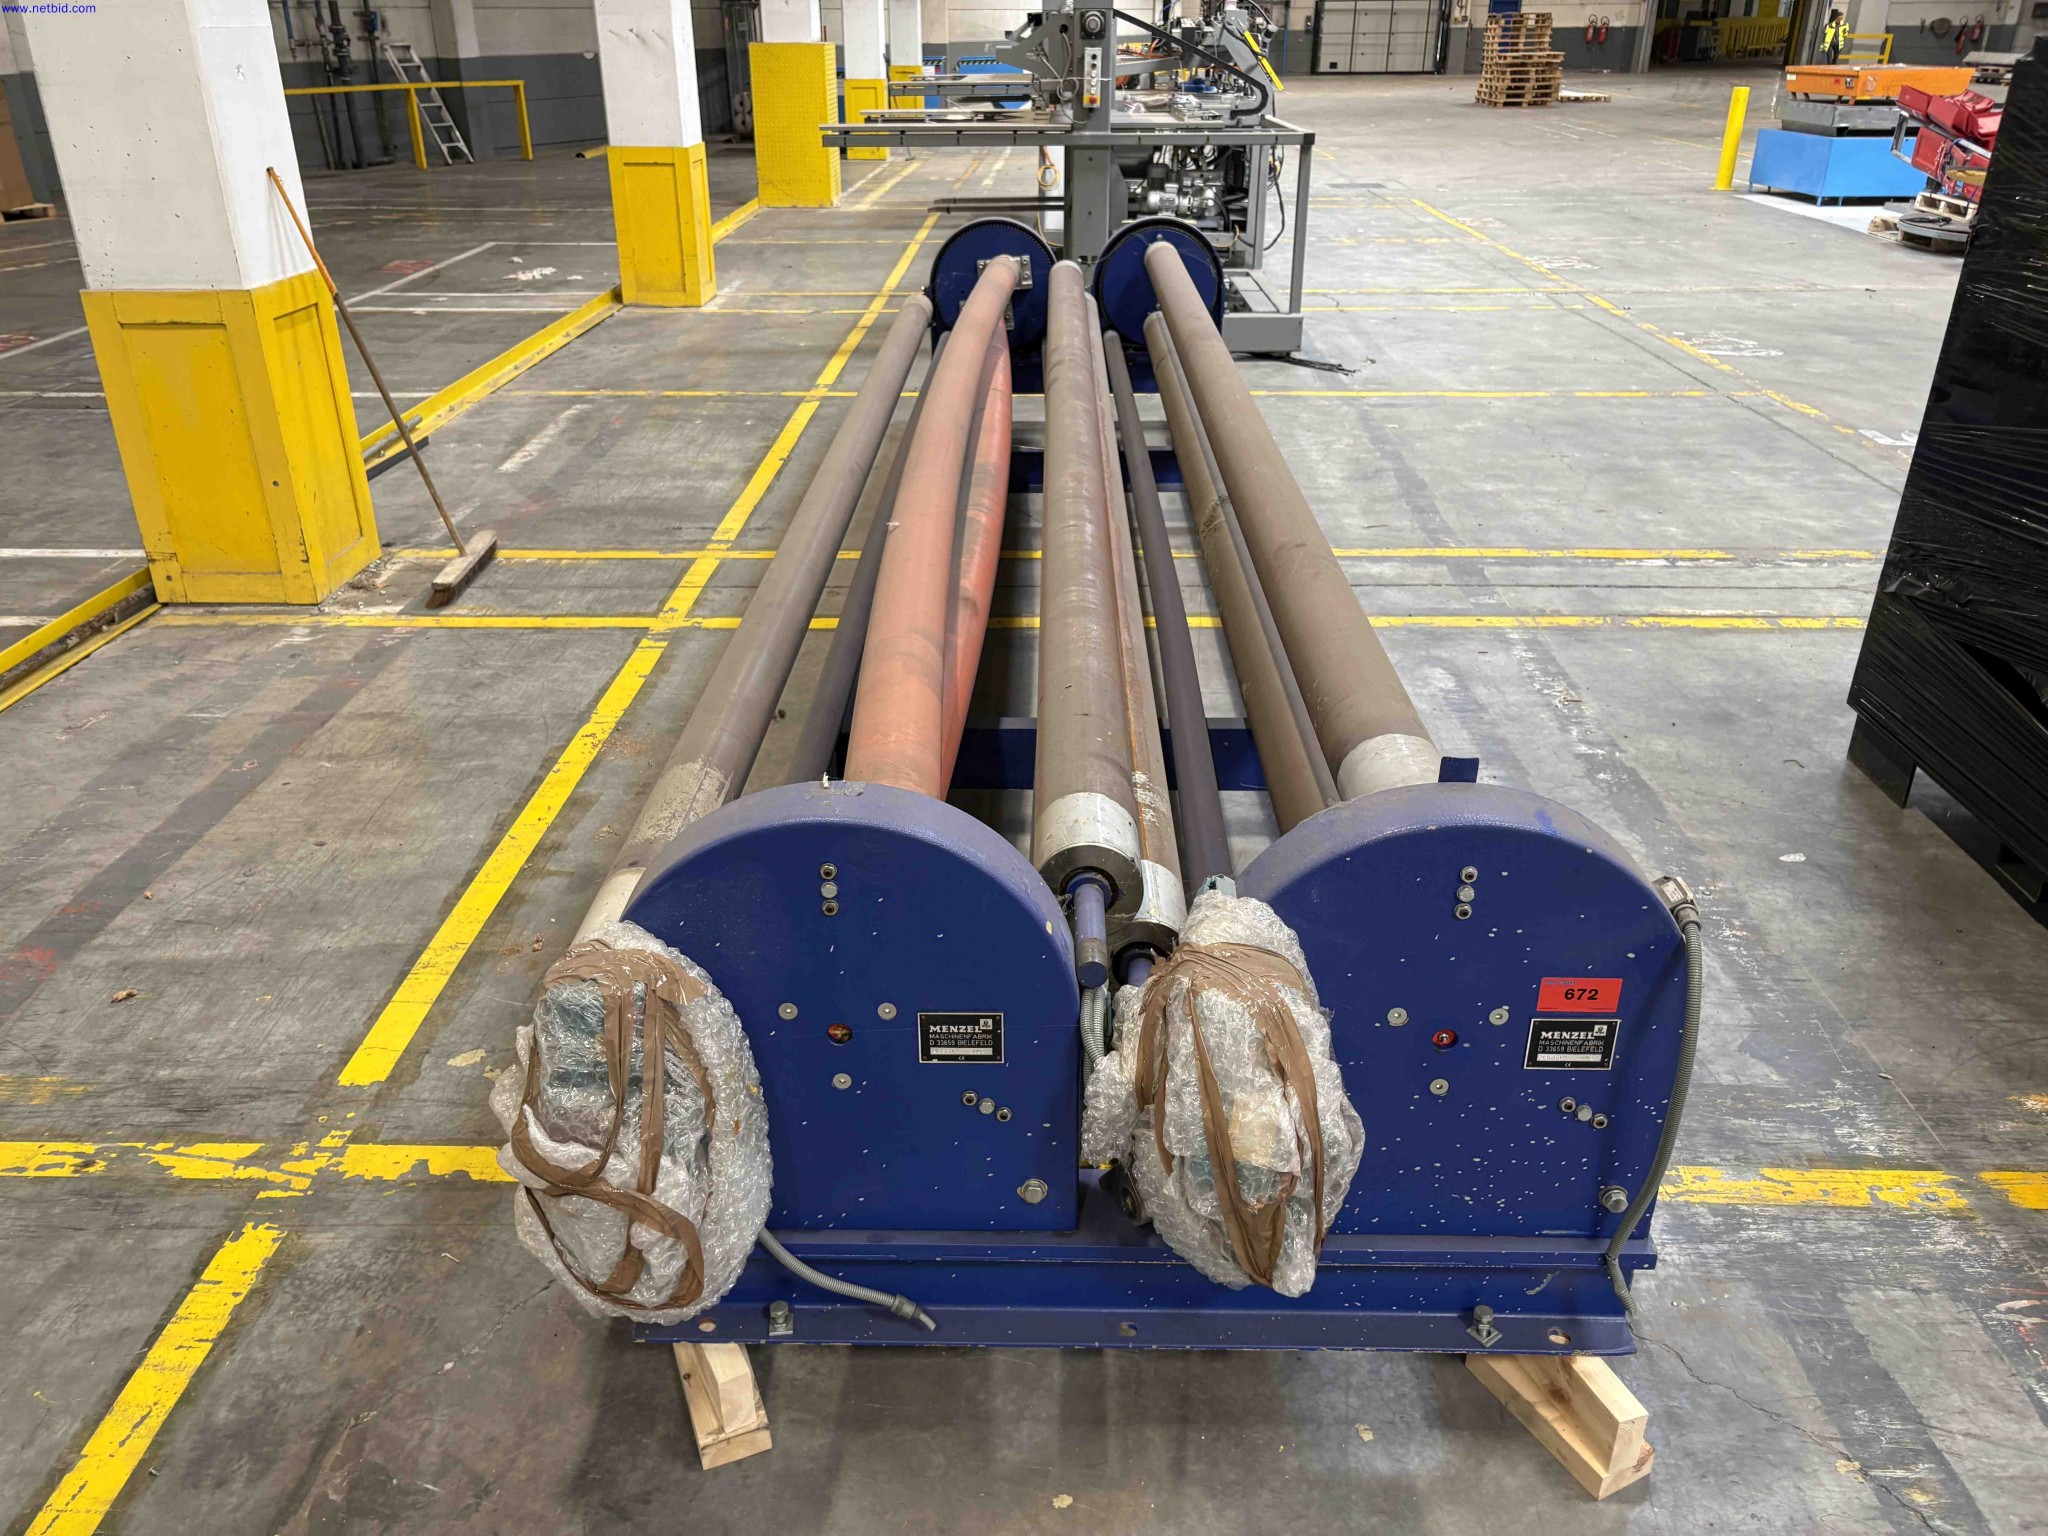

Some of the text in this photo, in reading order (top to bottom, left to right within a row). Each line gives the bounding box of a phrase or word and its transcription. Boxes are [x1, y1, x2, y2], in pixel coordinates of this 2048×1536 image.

[1564, 988, 1599, 1001] 672
[929, 1025, 982, 1033] MENZEL
[1540, 1031, 1595, 1040] MENZEL
